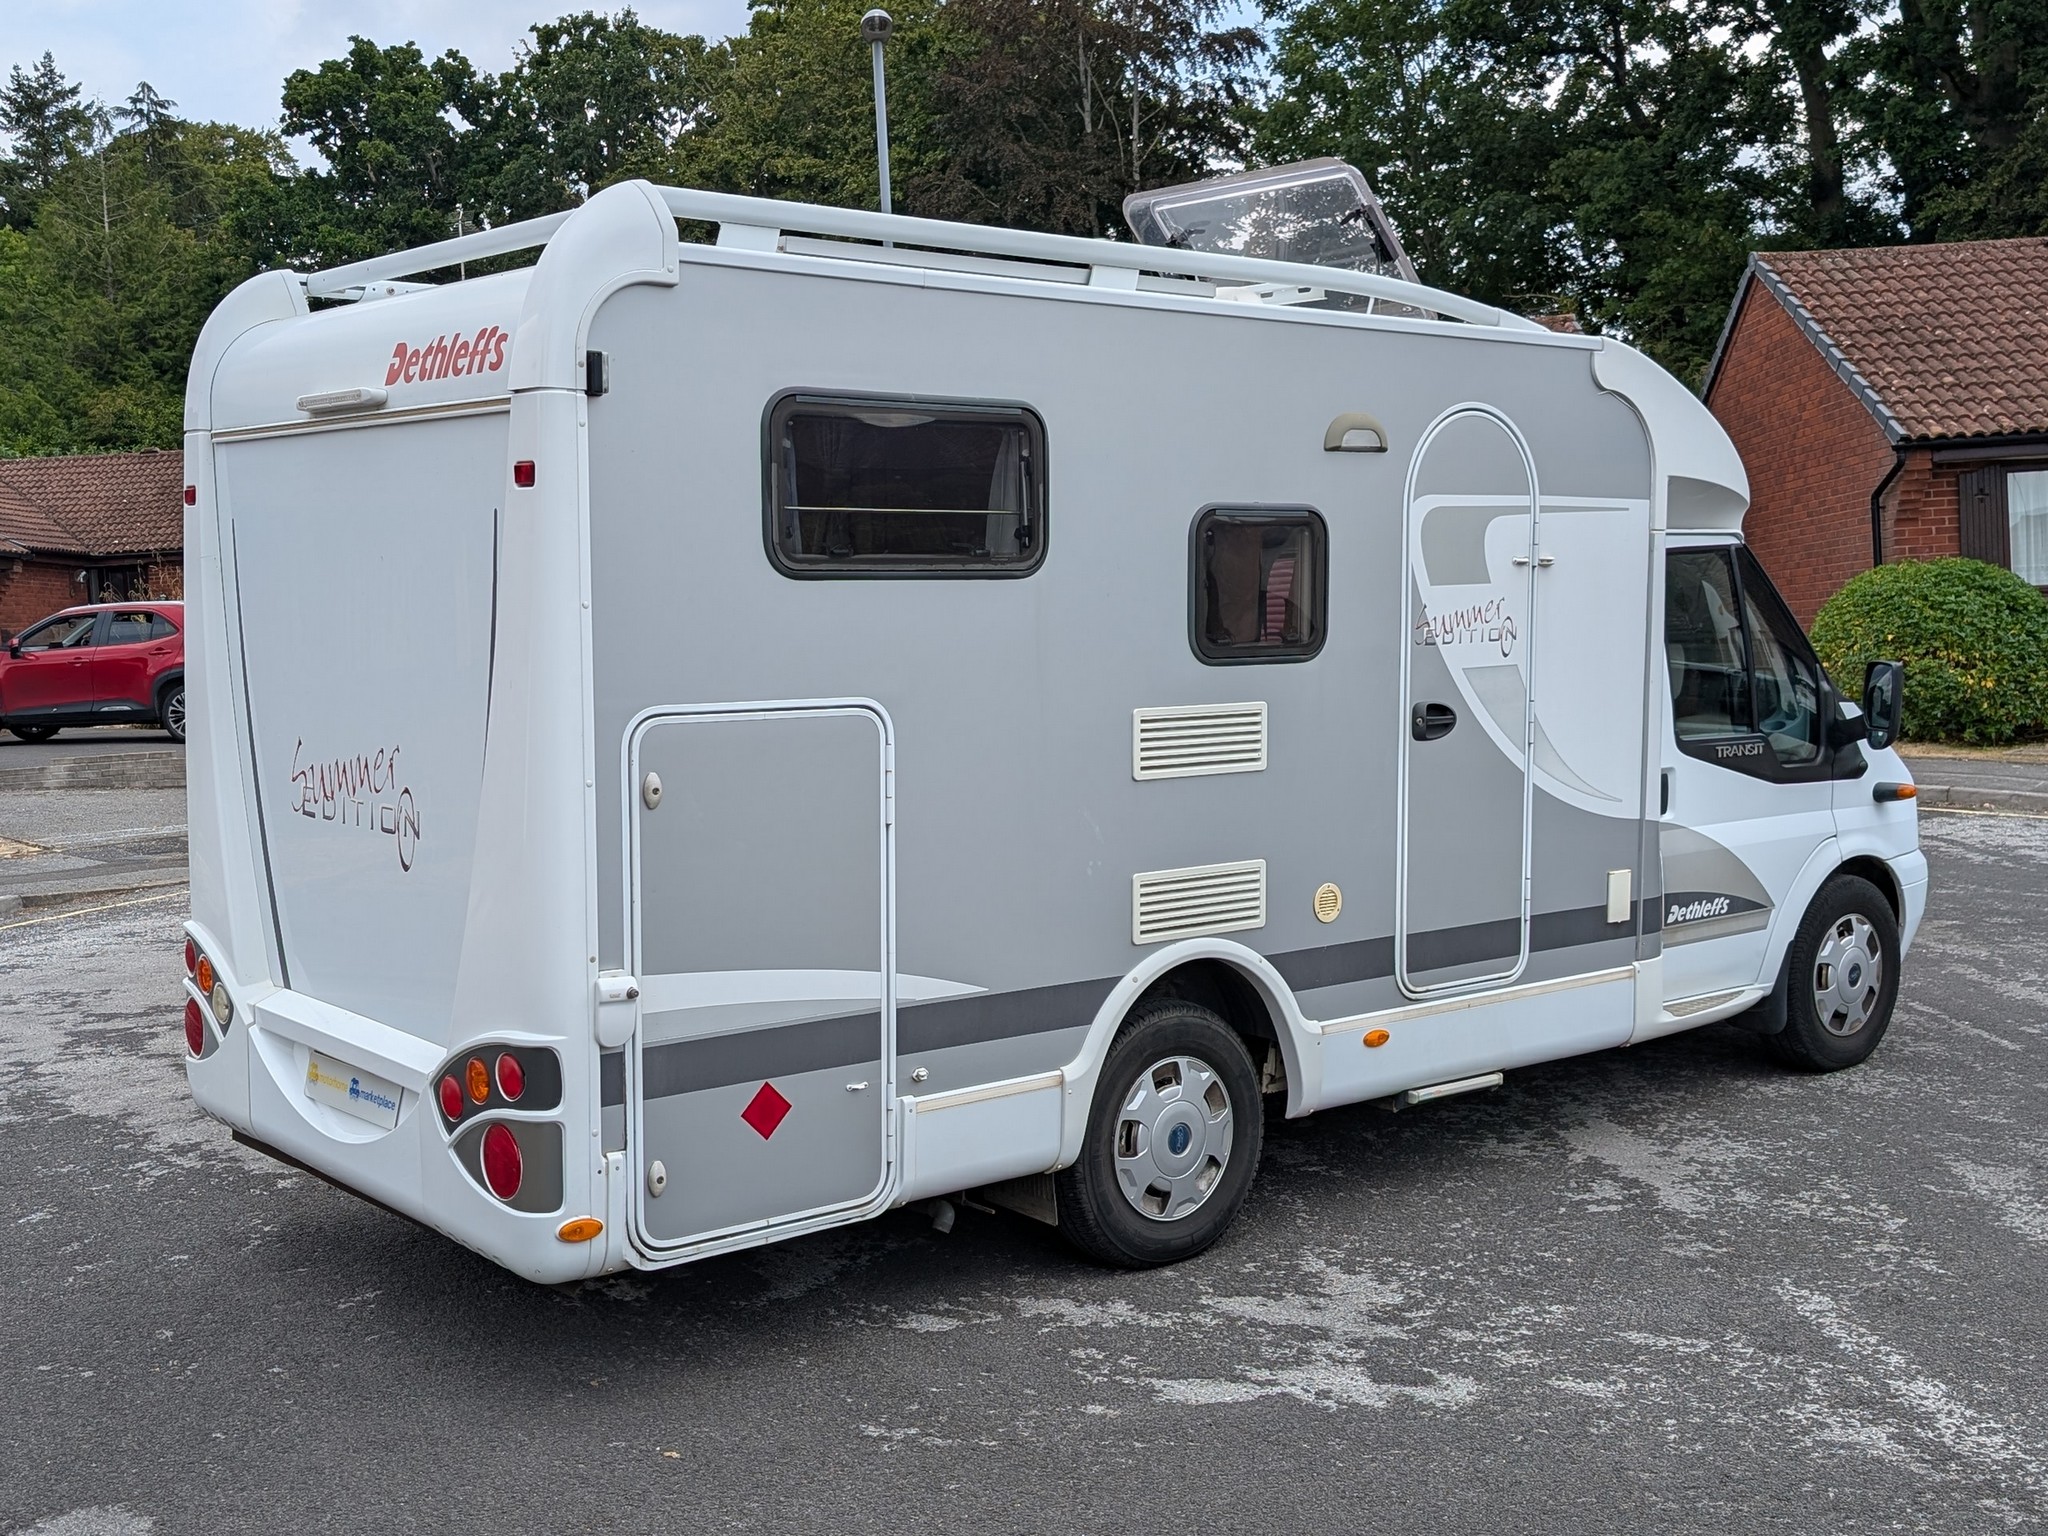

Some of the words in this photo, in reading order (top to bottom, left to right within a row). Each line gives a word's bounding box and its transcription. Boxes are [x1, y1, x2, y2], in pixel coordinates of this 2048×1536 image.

[384, 325, 509, 386] Dethleffs
[1415, 596, 1505, 645] Summer
[1424, 625, 1518, 650] EDITION
[1716, 743, 1765, 758] TRANSIT
[291, 736, 400, 812] Summer
[302, 786, 420, 848] EDITION
[1666, 896, 1731, 924] Dethleffs
[361, 1089, 396, 1111] marketplace
